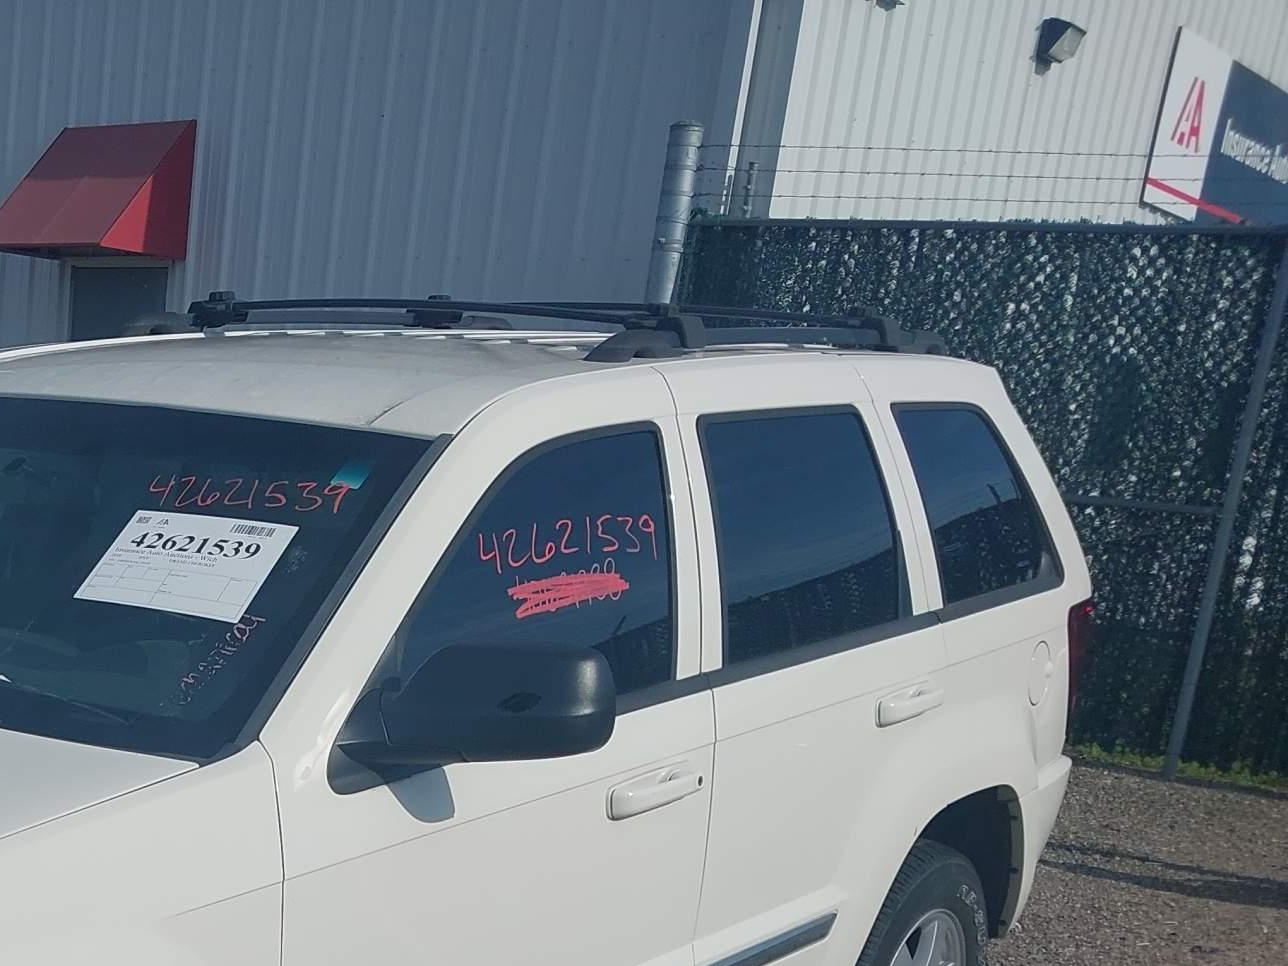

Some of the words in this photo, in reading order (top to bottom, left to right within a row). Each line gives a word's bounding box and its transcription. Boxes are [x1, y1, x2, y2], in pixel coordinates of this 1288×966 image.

[1220, 118, 1272, 174] Insurance
[149, 474, 350, 514] 42621539
[130, 531, 262, 560] 42621539
[478, 514, 658, 574] 42621539
